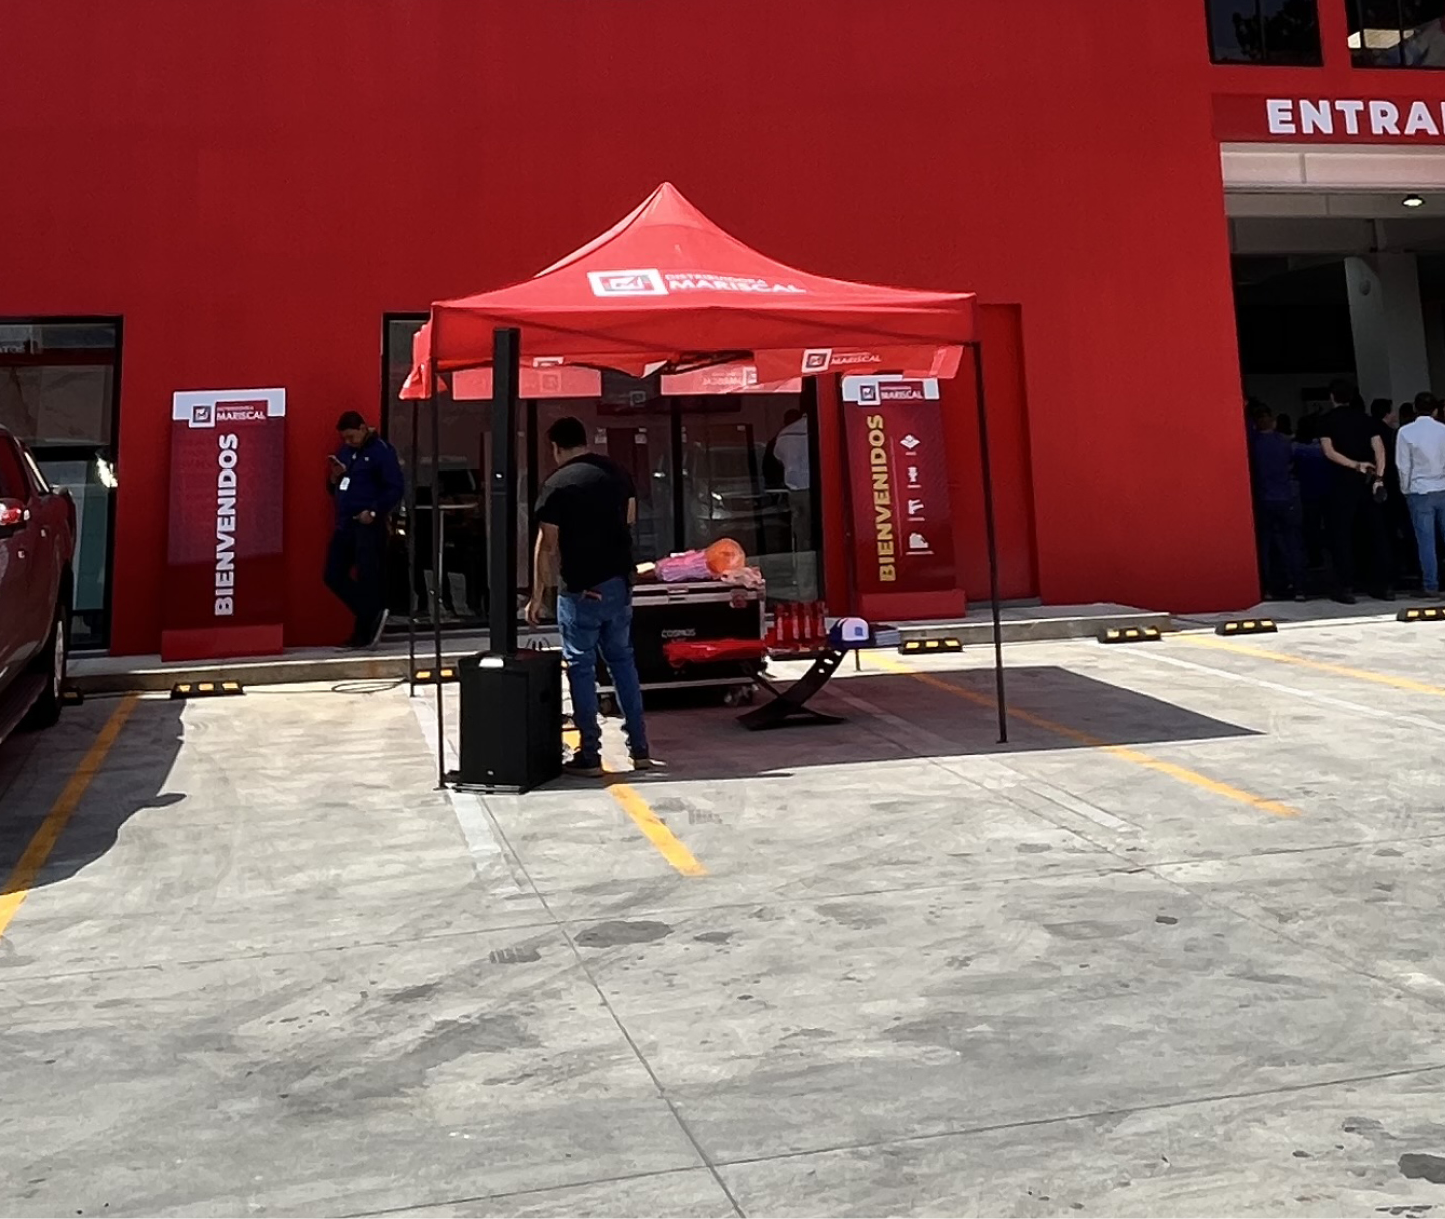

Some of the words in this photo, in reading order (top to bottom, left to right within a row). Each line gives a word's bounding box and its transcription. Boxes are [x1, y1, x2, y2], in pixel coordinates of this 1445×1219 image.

[669, 279, 807, 294] MARISCAL
[880, 389, 924, 400] MARISCAL
[215, 411, 267, 422] MARISCAL
[866, 414, 897, 582] BIENVENIDOS
[214, 433, 239, 617] BIENVENIDOS
